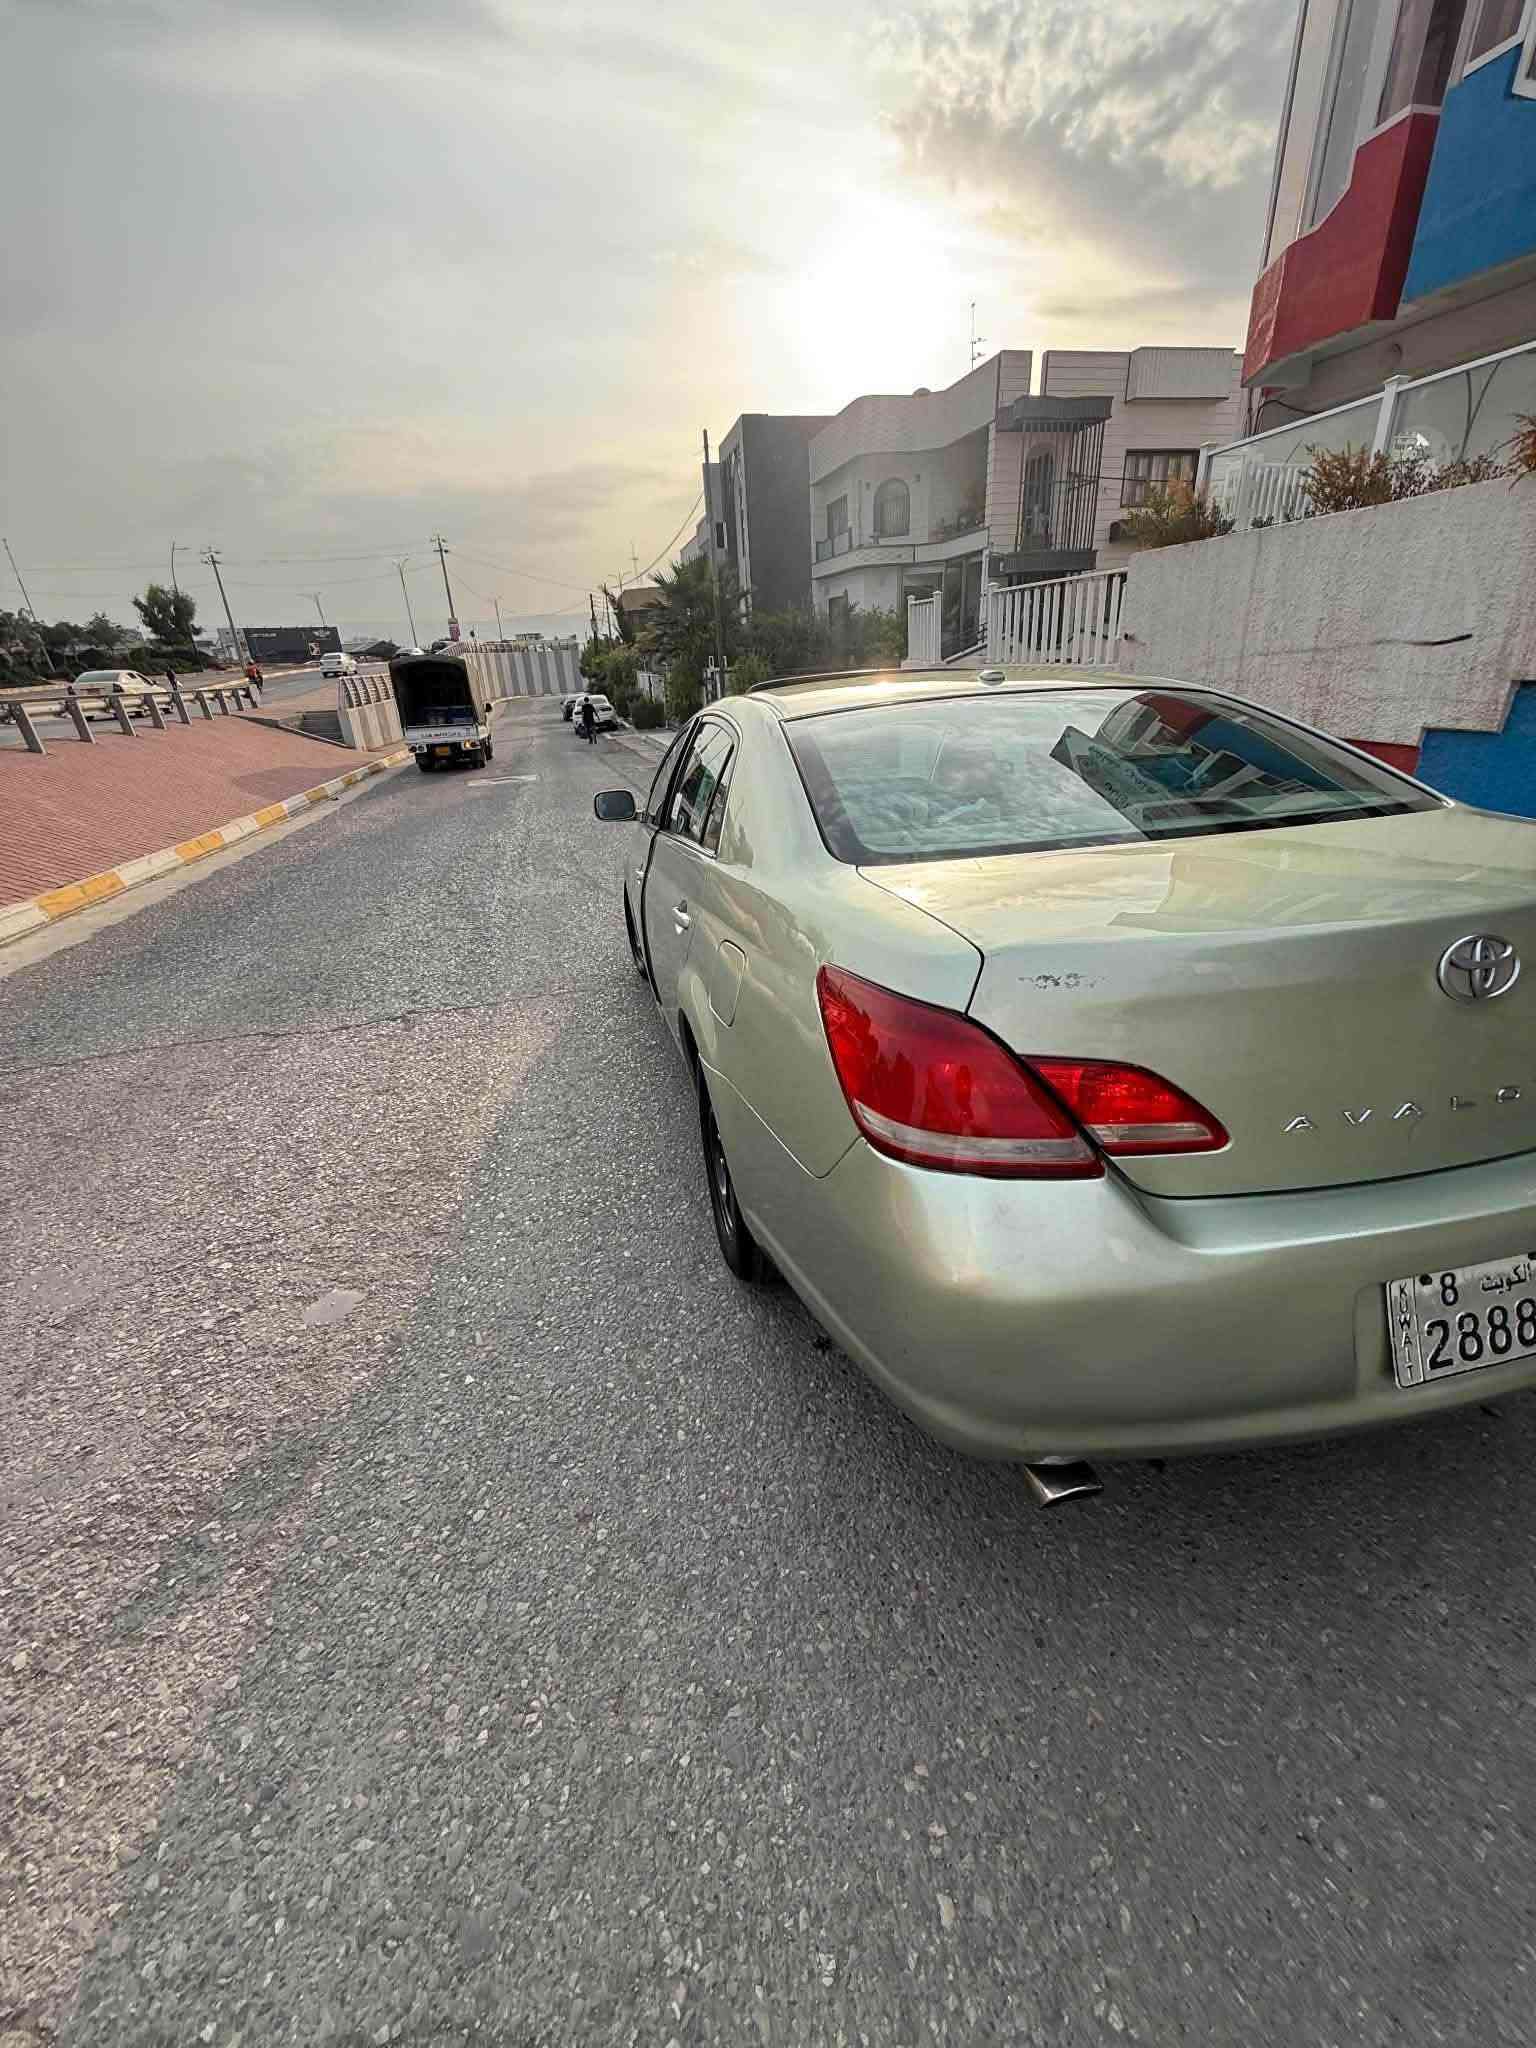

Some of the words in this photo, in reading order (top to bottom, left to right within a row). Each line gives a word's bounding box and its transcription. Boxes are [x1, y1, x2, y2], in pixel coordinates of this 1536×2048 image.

[1440, 1272, 1459, 1306] 8
[1398, 1280, 1413, 1380] KUWAIT
[1424, 1297, 1536, 1370] 2888
